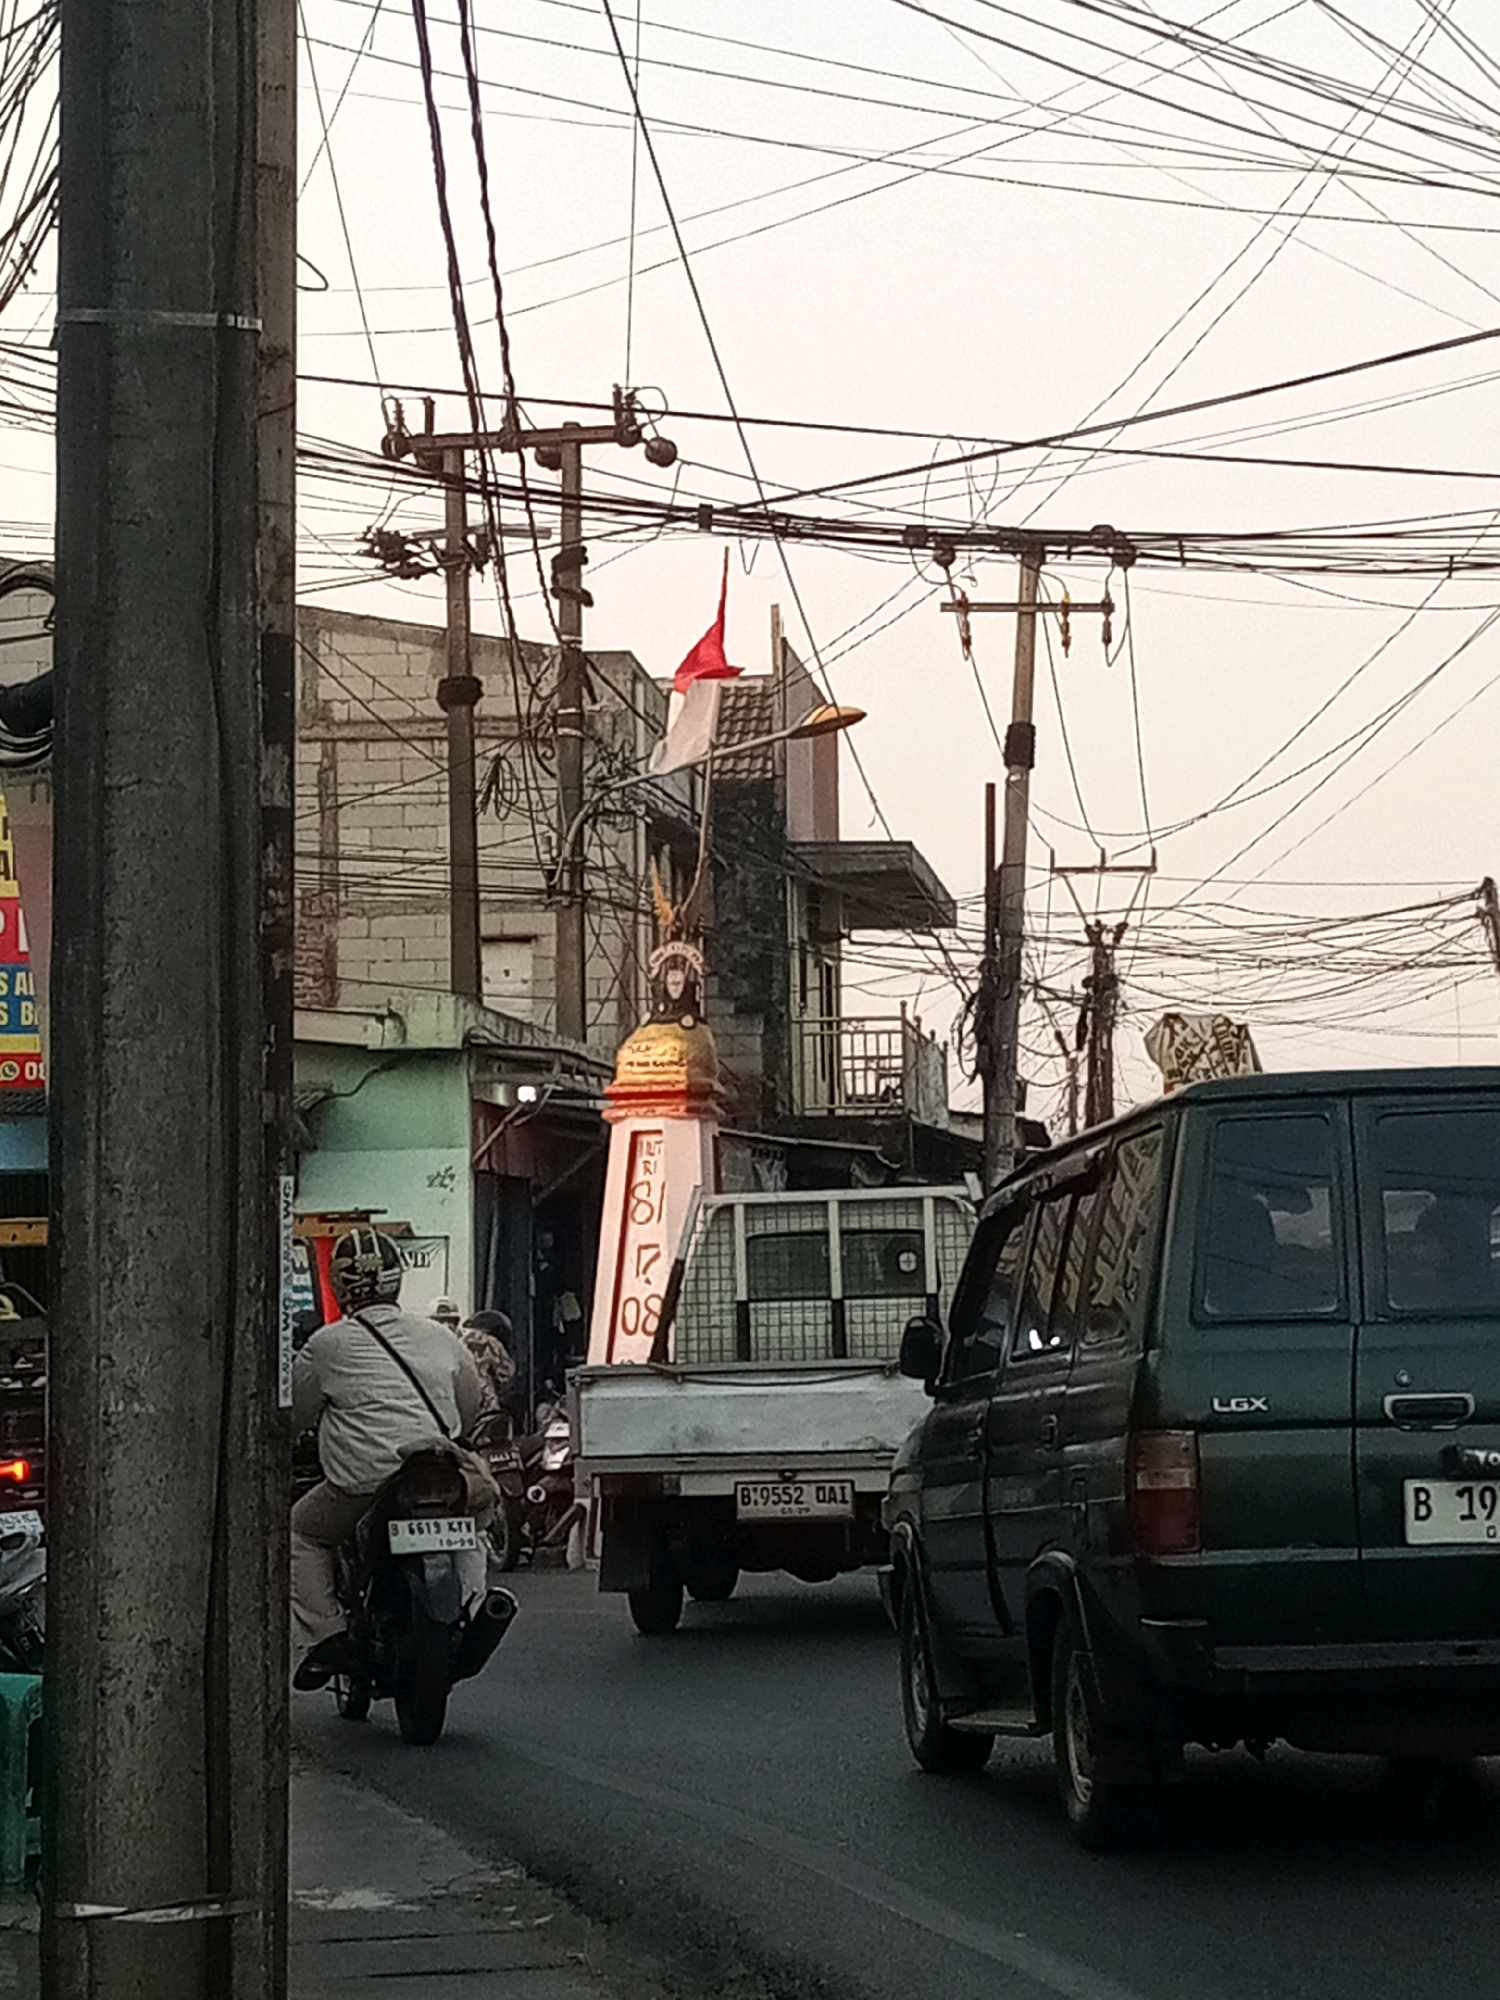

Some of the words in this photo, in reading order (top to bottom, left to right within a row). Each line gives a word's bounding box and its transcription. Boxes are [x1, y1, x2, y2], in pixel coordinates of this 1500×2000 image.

[1212, 1396, 1269, 1413] LGX
[760, 1486, 805, 1506] 9552
[1413, 1486, 1432, 1521] B
